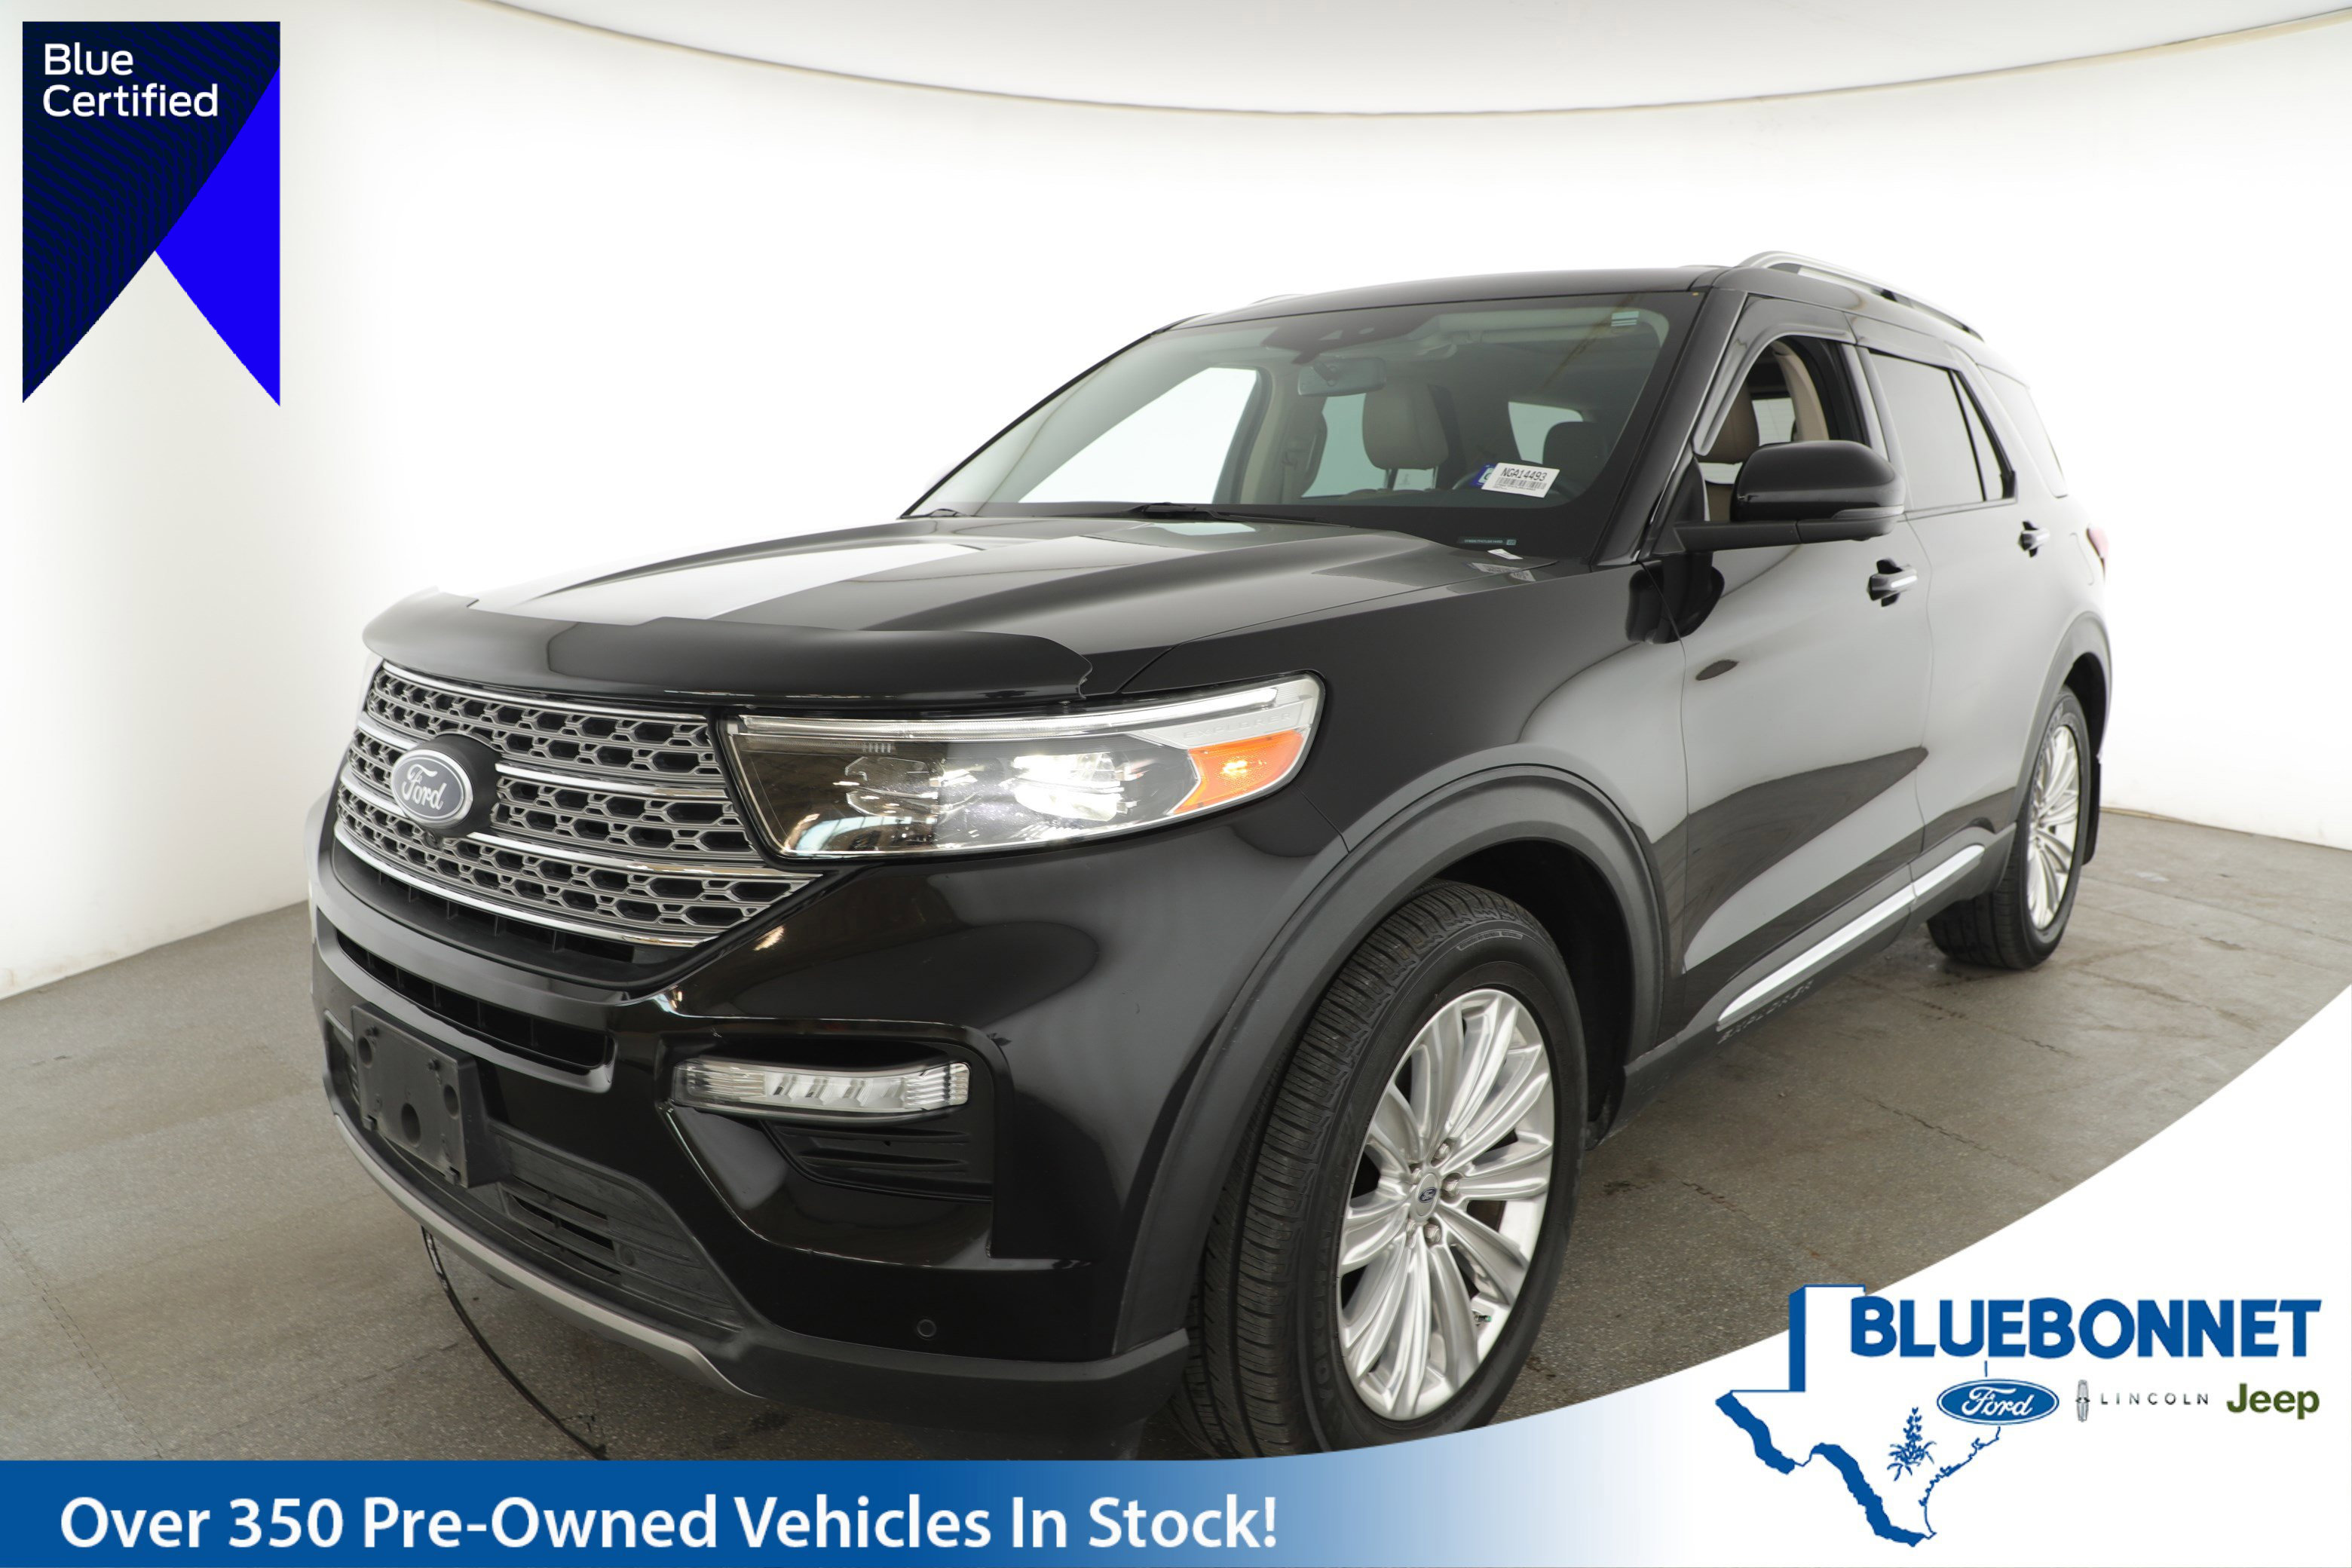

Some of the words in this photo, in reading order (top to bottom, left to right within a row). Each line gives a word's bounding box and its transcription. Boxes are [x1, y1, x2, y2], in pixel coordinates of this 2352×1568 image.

[1501, 467, 1548, 482] NGA14493
[1183, 712, 1292, 740] EXPLORER
[401, 764, 447, 810] Ford
